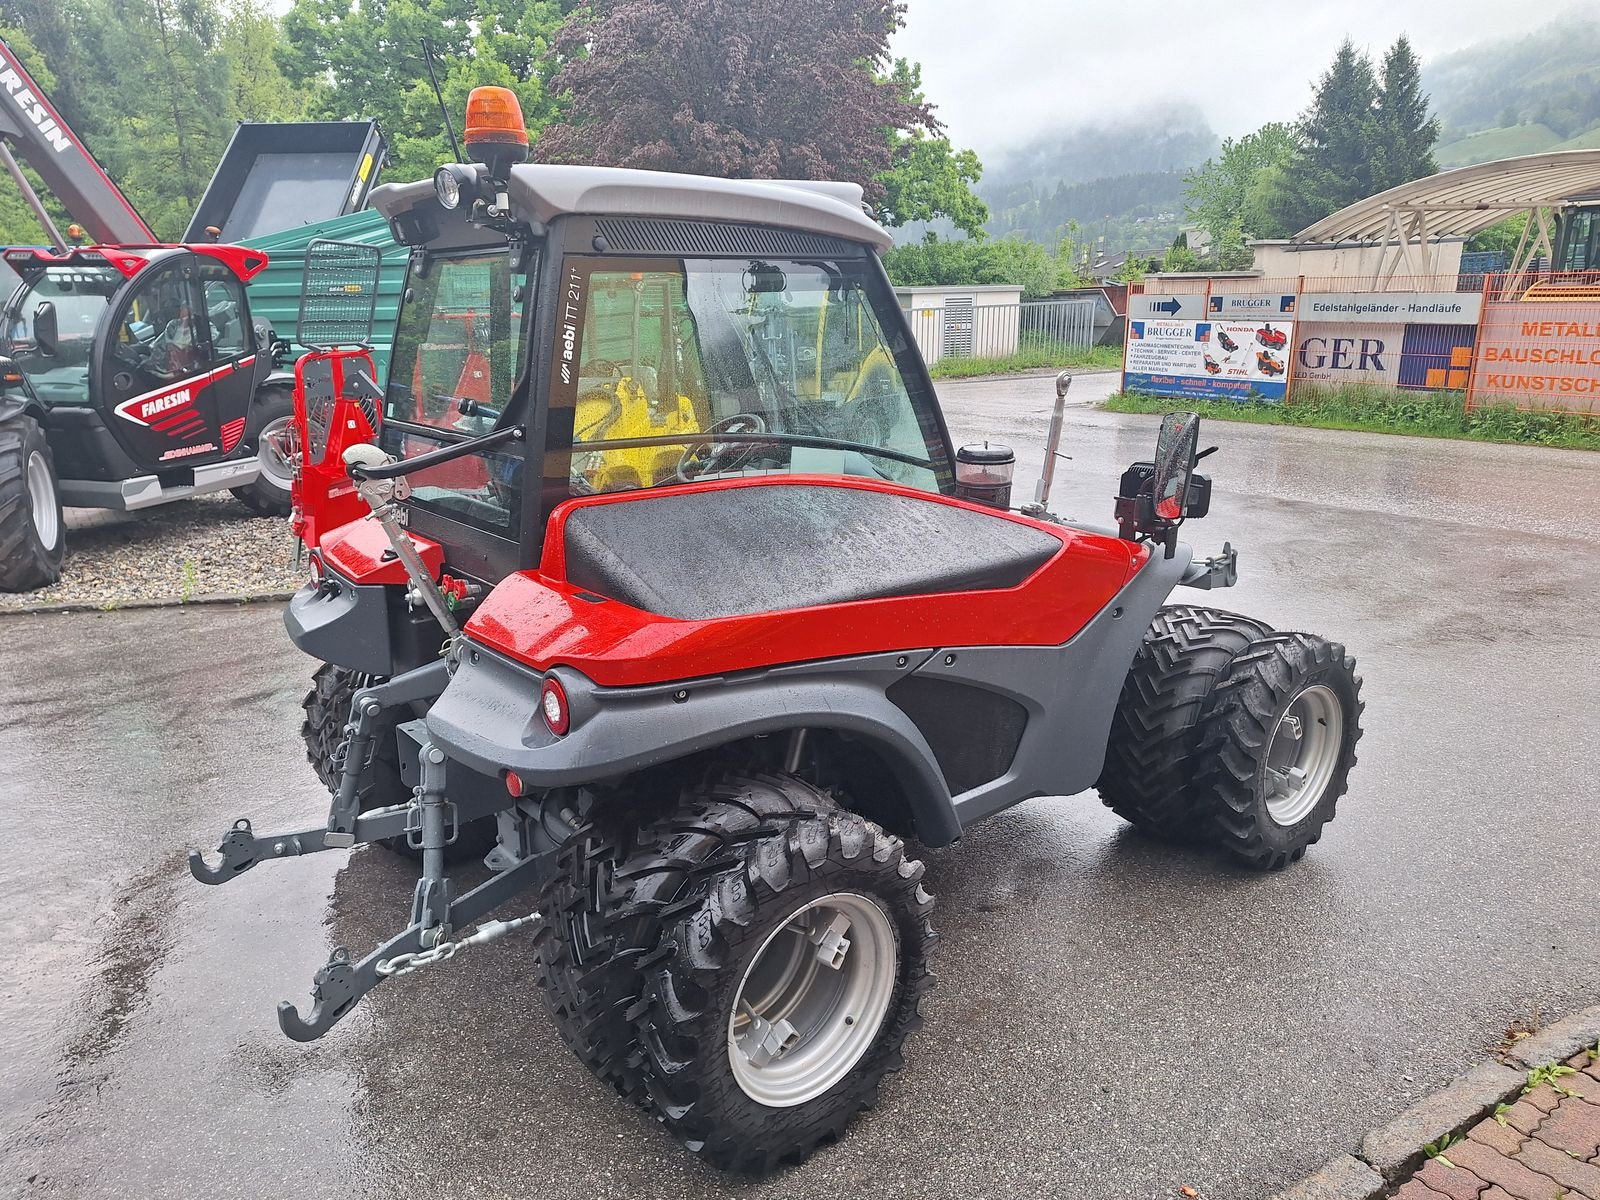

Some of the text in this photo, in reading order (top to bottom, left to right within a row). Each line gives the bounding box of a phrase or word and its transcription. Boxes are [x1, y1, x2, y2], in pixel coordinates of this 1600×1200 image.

[0, 54, 72, 153] RESIN
[565, 302, 578, 321] TT
[1231, 299, 1271, 308] BRUGGER
[1313, 303, 1400, 315] Edelstahlgeländer
[1407, 303, 1462, 314] Handläufe
[1147, 327, 1192, 337] BRUGGER
[562, 324, 577, 361] aebi
[1300, 336, 1386, 371] GER
[1227, 368, 1249, 376] STIHL
[1151, 375, 1176, 384] flexibel
[1180, 378, 1207, 387] schnell
[1212, 380, 1252, 391] kompetent
[141, 388, 191, 418] FARESIN
